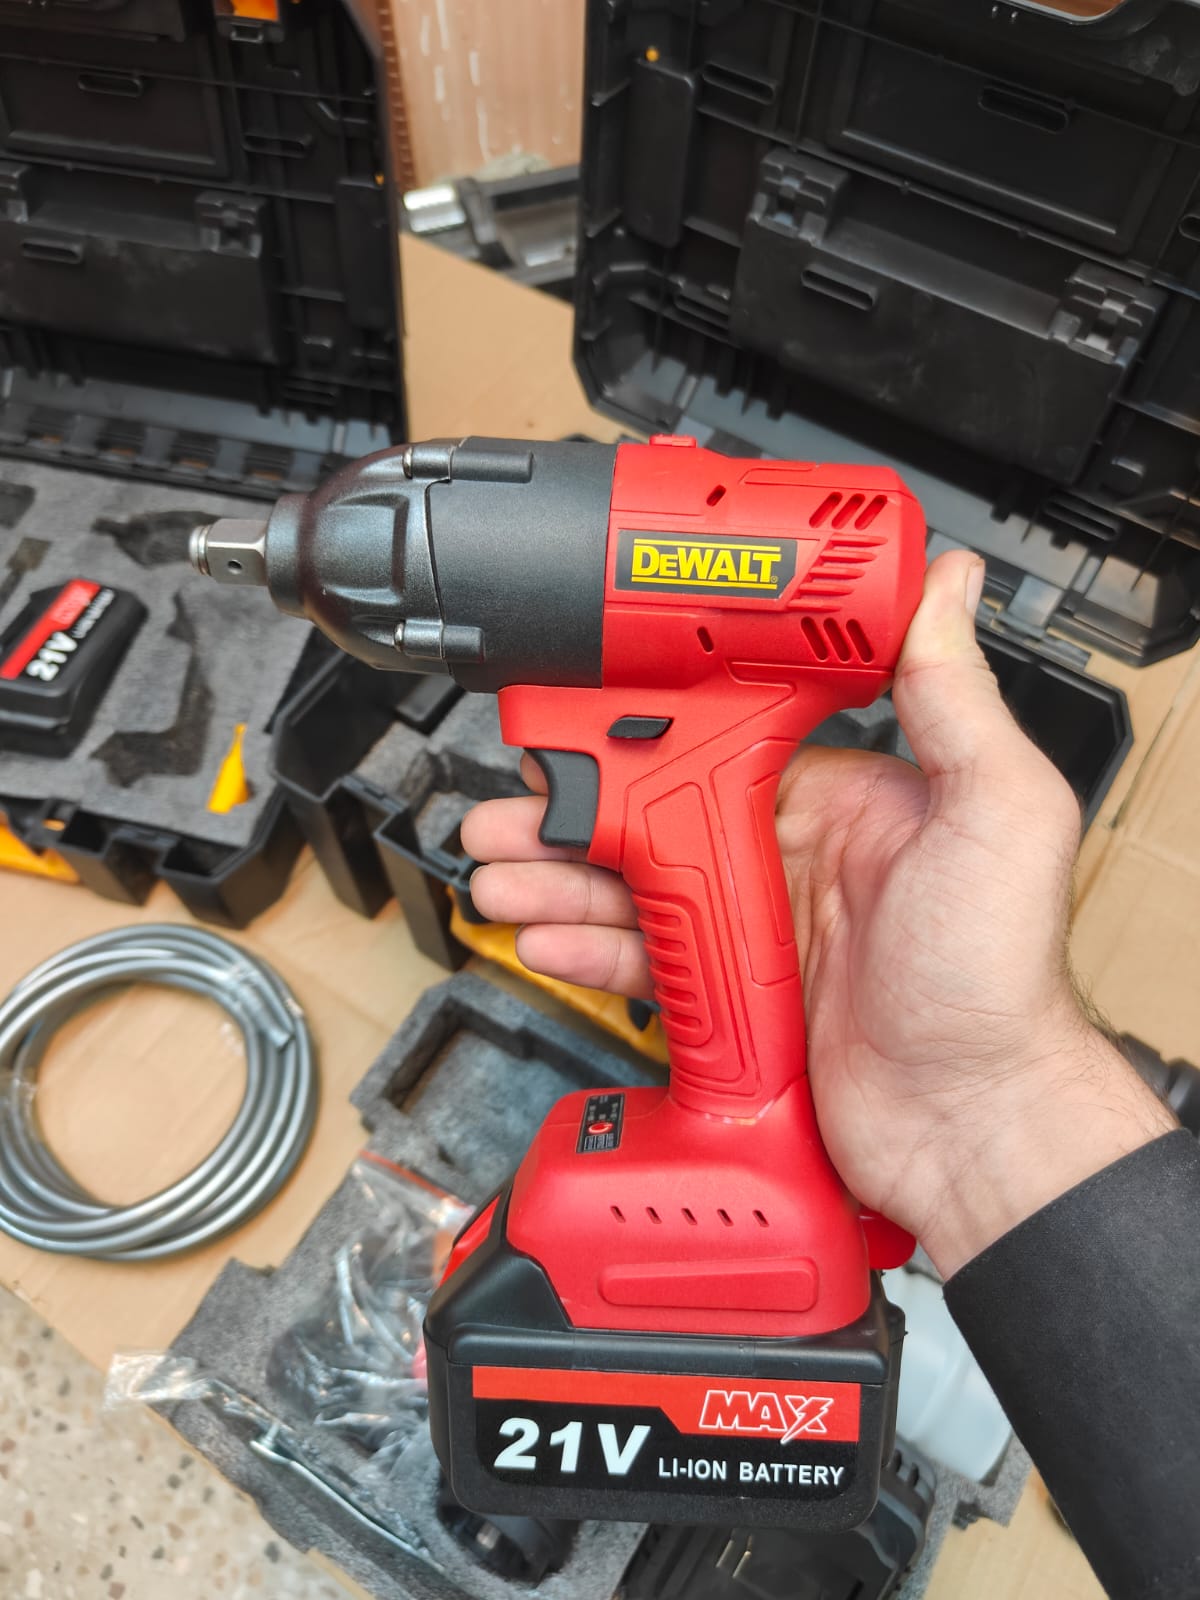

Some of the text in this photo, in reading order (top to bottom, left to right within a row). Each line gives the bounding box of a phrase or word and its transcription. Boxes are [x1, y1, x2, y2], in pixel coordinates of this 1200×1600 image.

[699, 1389, 834, 1444] MAX
[658, 1457, 844, 1485] LI-ION BATTERY
